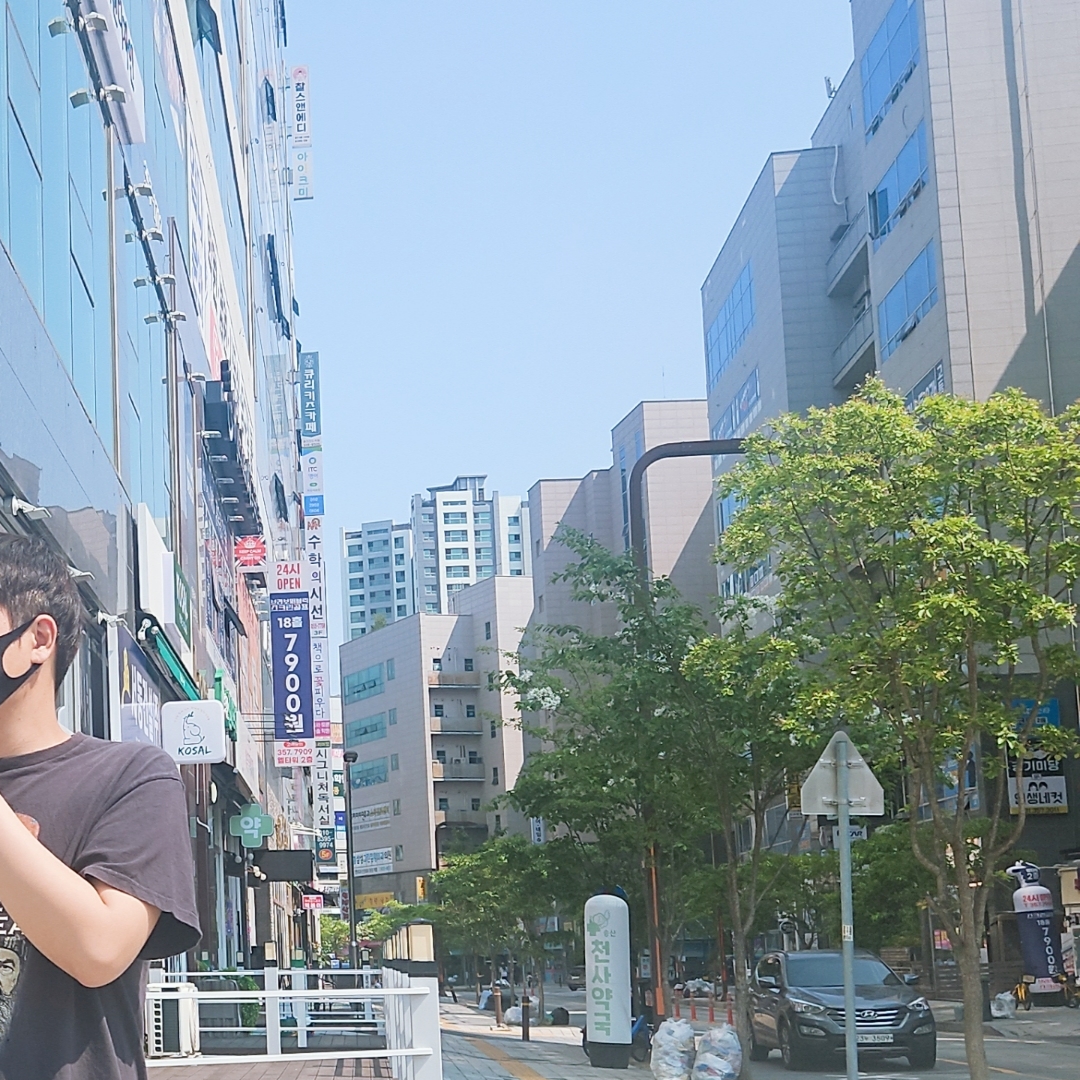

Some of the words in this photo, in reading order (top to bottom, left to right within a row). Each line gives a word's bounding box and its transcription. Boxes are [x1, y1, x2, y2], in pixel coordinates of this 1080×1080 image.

[303, 368, 317, 433] 큐리키즈카페
[276, 563, 300, 575] 24시
[277, 578, 301, 590] OPEN
[177, 745, 212, 756] KOSAL
[240, 816, 262, 839] 약
[590, 939, 614, 1037] 천사약국
